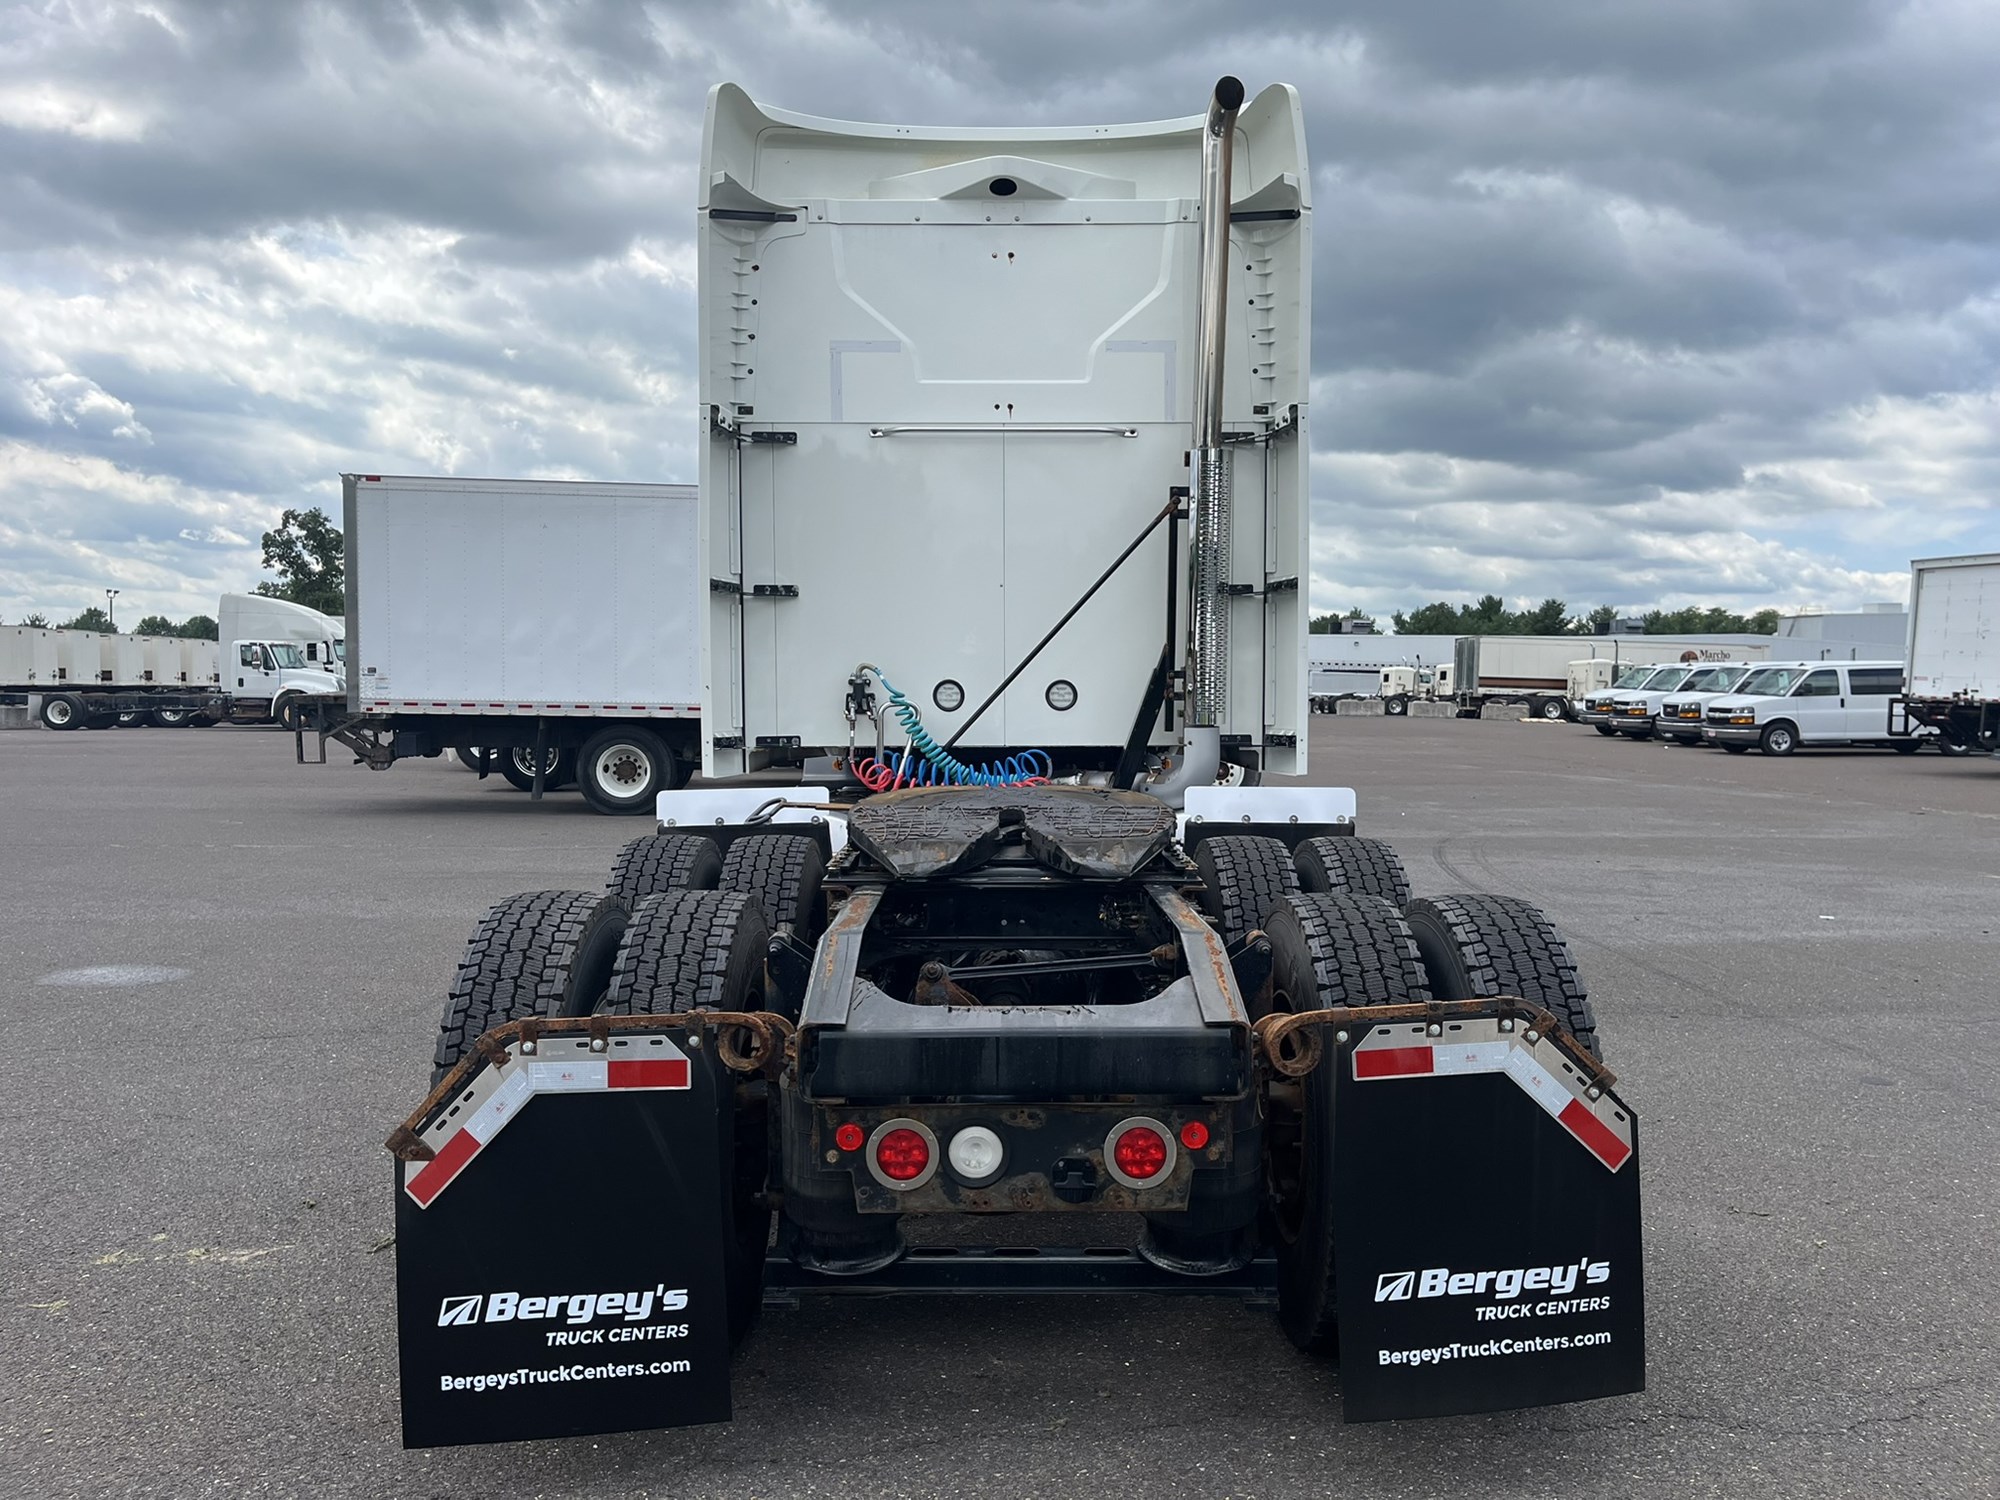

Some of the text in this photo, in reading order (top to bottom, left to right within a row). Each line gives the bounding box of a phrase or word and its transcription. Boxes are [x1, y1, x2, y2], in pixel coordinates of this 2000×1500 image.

[1699, 649, 1731, 659] Marcho
[1417, 1257, 1610, 1300] Bergey's
[484, 1283, 689, 1325] Bergey's
[1475, 1296, 1611, 1322] TRUCK CENTERS
[545, 1323, 690, 1347] TRUCK CENTERS
[1378, 1331, 1612, 1367] BergeysTruckCenters.com
[440, 1359, 691, 1392] BergeysTruckCenters.com
